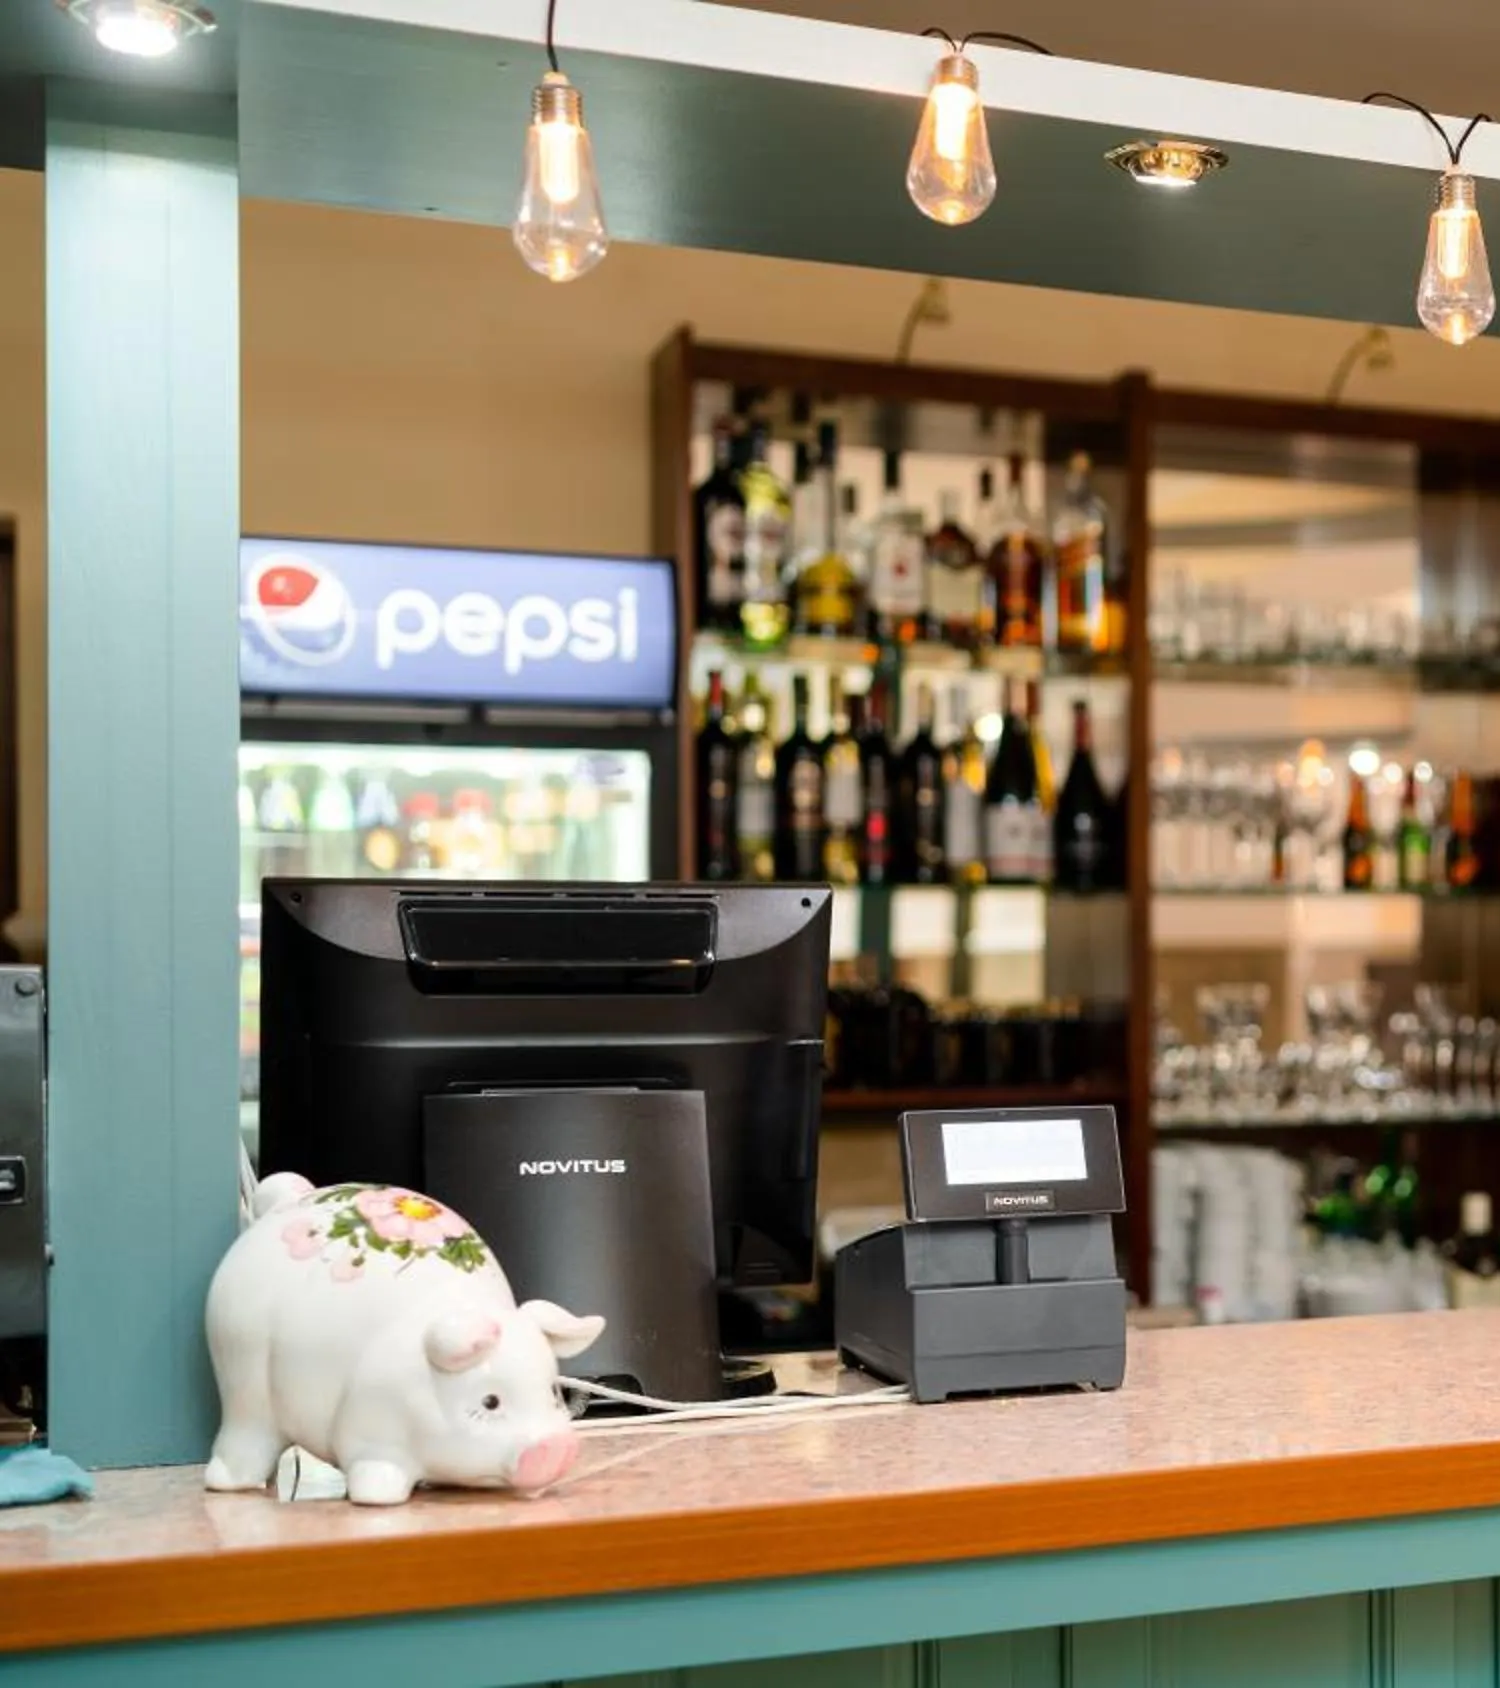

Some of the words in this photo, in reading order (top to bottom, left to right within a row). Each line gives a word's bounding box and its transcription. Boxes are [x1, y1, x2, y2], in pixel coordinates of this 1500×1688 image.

[374, 586, 639, 676] pepsi
[519, 1159, 626, 1175] NOVITUS
[993, 1195, 1049, 1205] NOVITUS
